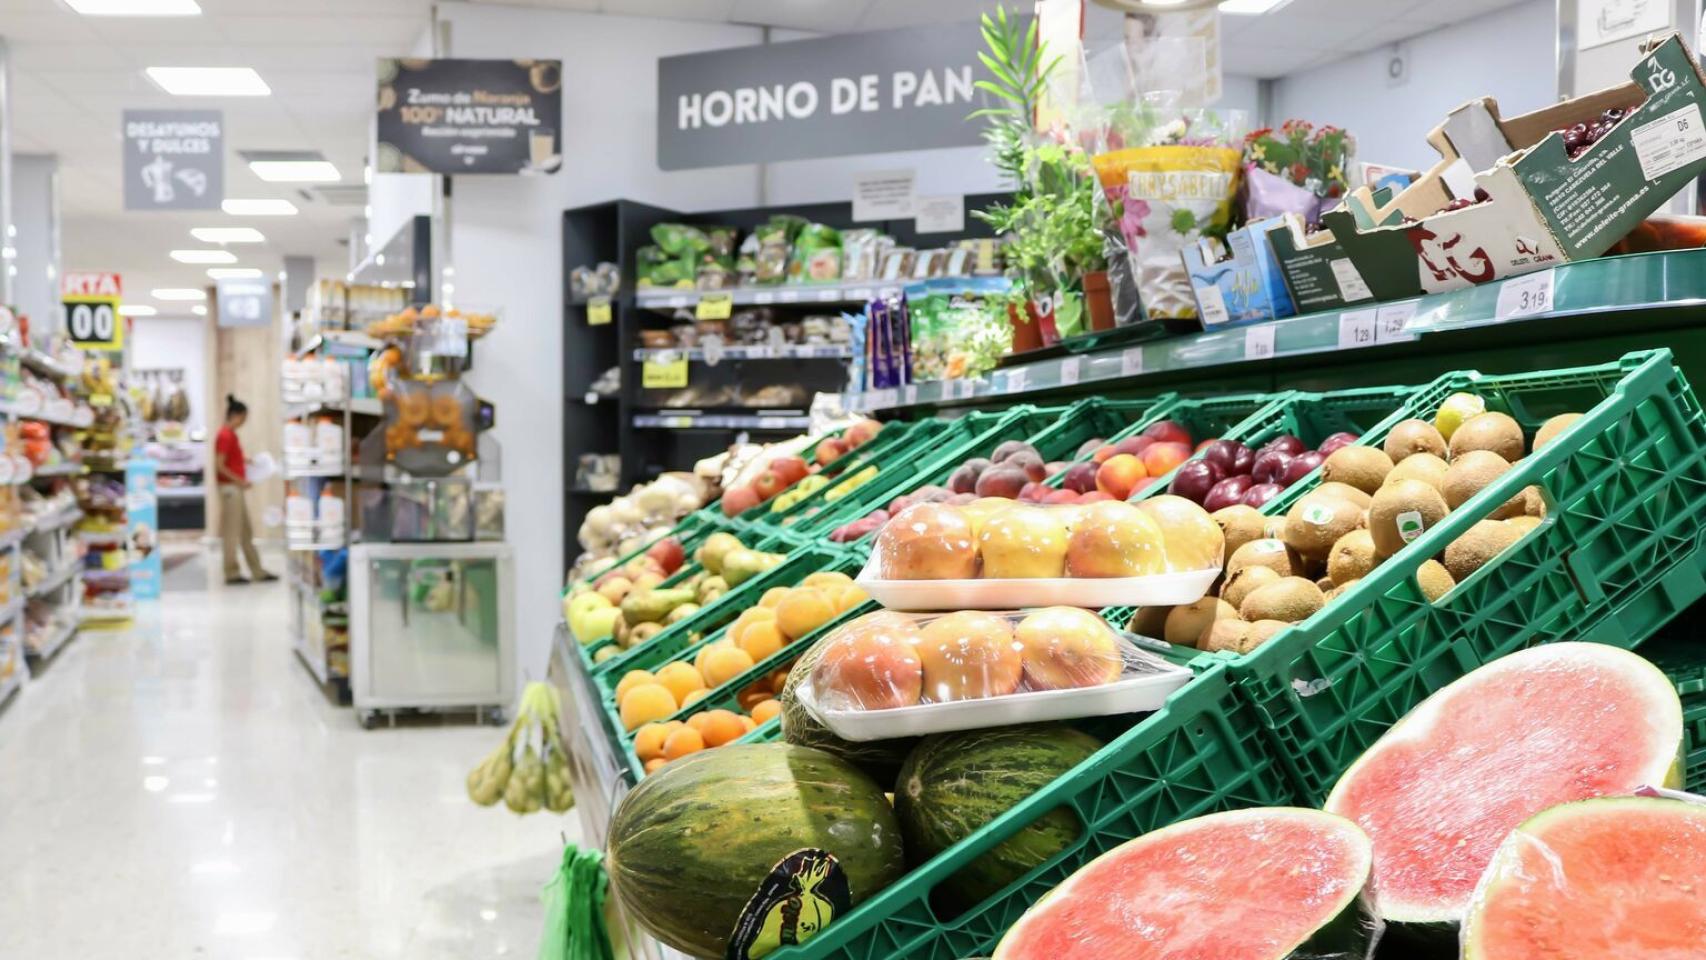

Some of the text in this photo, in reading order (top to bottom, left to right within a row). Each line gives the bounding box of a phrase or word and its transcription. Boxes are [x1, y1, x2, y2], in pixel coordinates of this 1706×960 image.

[1648, 68, 1676, 93] DG
[408, 88, 450, 104] Zumo
[678, 65, 973, 130] HORNO DE PAN
[446, 107, 541, 125] NATURAL
[127, 121, 220, 138] DESAYUNOS
[138, 138, 210, 154] Y DULCES
[1575, 186, 1649, 248] www.deleite-grana.es
